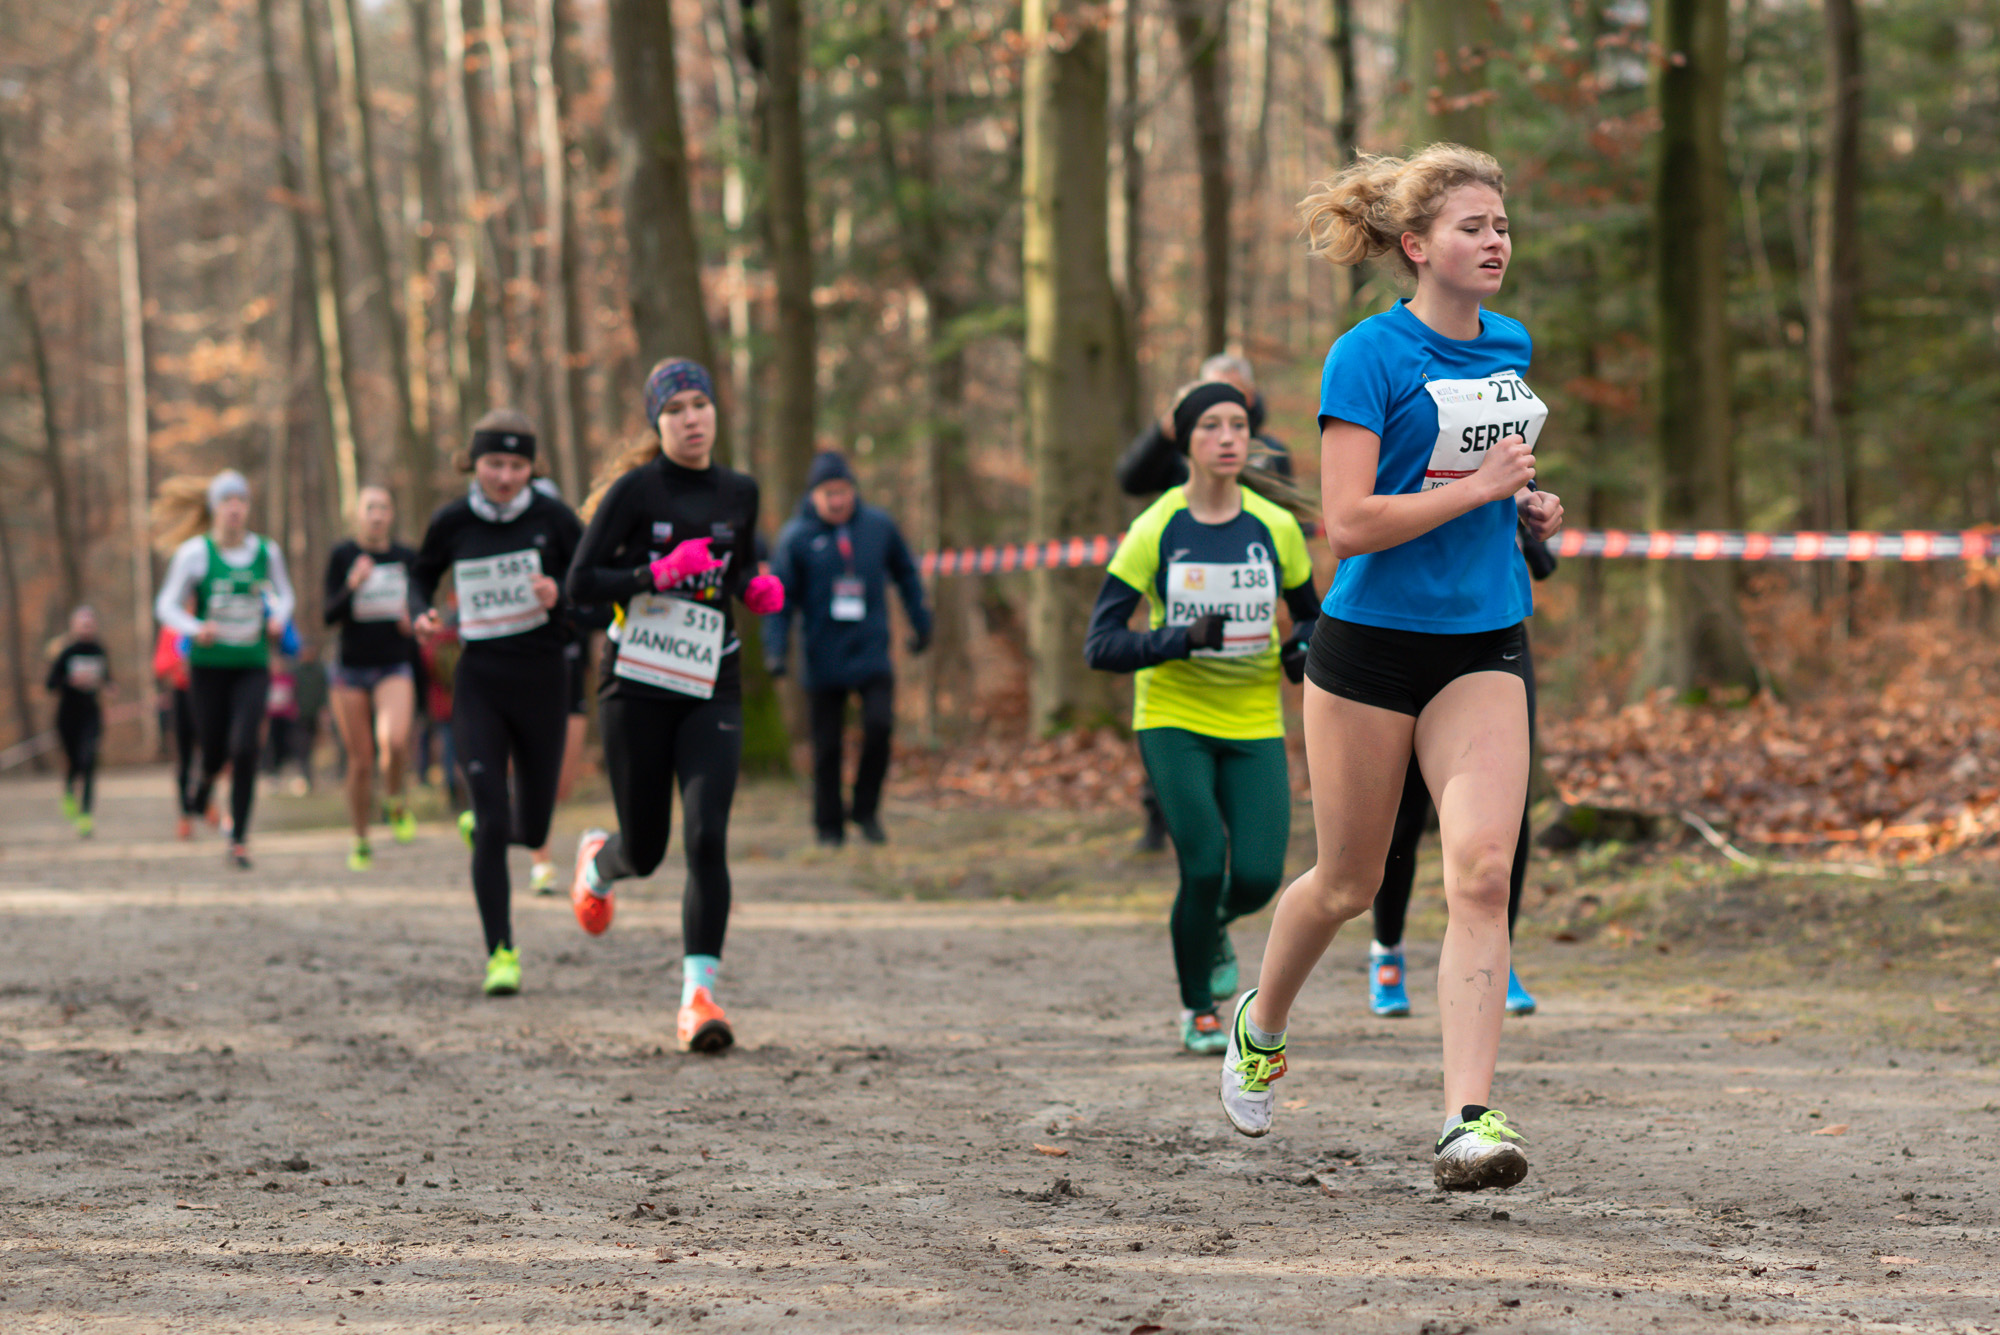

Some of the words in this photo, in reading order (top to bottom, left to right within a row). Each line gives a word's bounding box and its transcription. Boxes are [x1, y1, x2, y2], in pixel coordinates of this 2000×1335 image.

[1488, 379, 1534, 403] 270
[1459, 419, 1530, 454] SEREK
[1231, 568, 1269, 589] 138
[683, 607, 719, 633] 519
[628, 626, 713, 666] JANICKA
